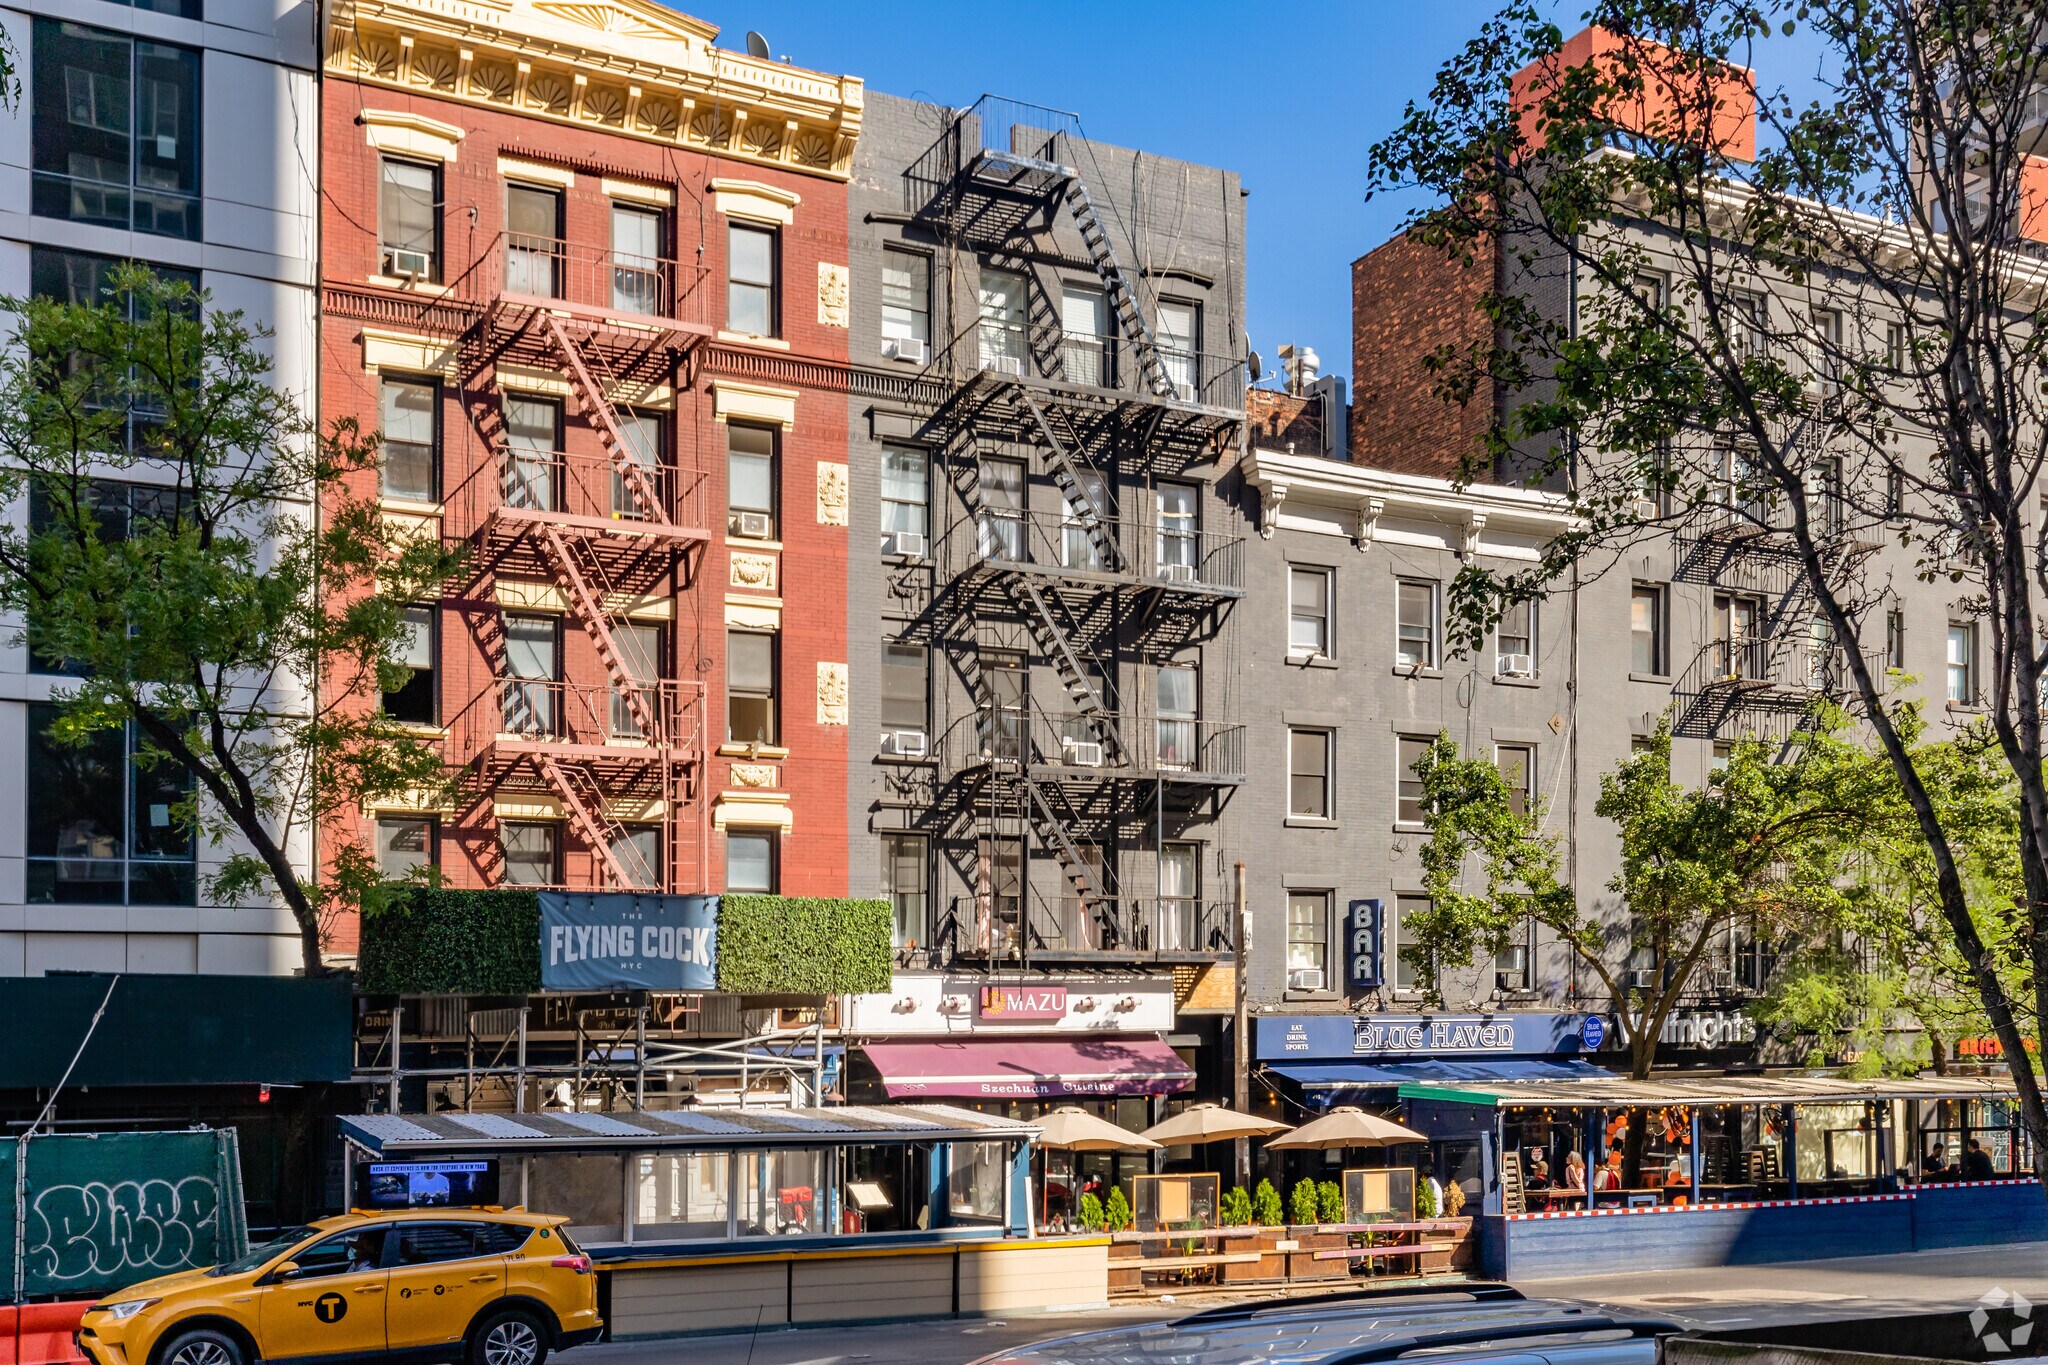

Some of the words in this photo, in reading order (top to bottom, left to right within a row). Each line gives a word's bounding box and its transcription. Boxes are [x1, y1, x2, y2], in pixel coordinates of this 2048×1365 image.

[622, 912, 644, 920] THE
[550, 925, 635, 967] FLYING
[641, 925, 710, 967] COCK
[1353, 903, 1373, 979] BAR
[620, 962, 643, 970] NYC
[1006, 993, 1065, 1012] MAZU
[365, 1016, 394, 1027] DRIN
[1354, 1023, 1424, 1049] BLUE
[1430, 1022, 1514, 1048] HAVEN
[981, 1083, 1049, 1094] Szechuan
[1062, 1082, 1115, 1092] Cuisine
[298, 1300, 314, 1308] NYC
[321, 1297, 341, 1320] T
